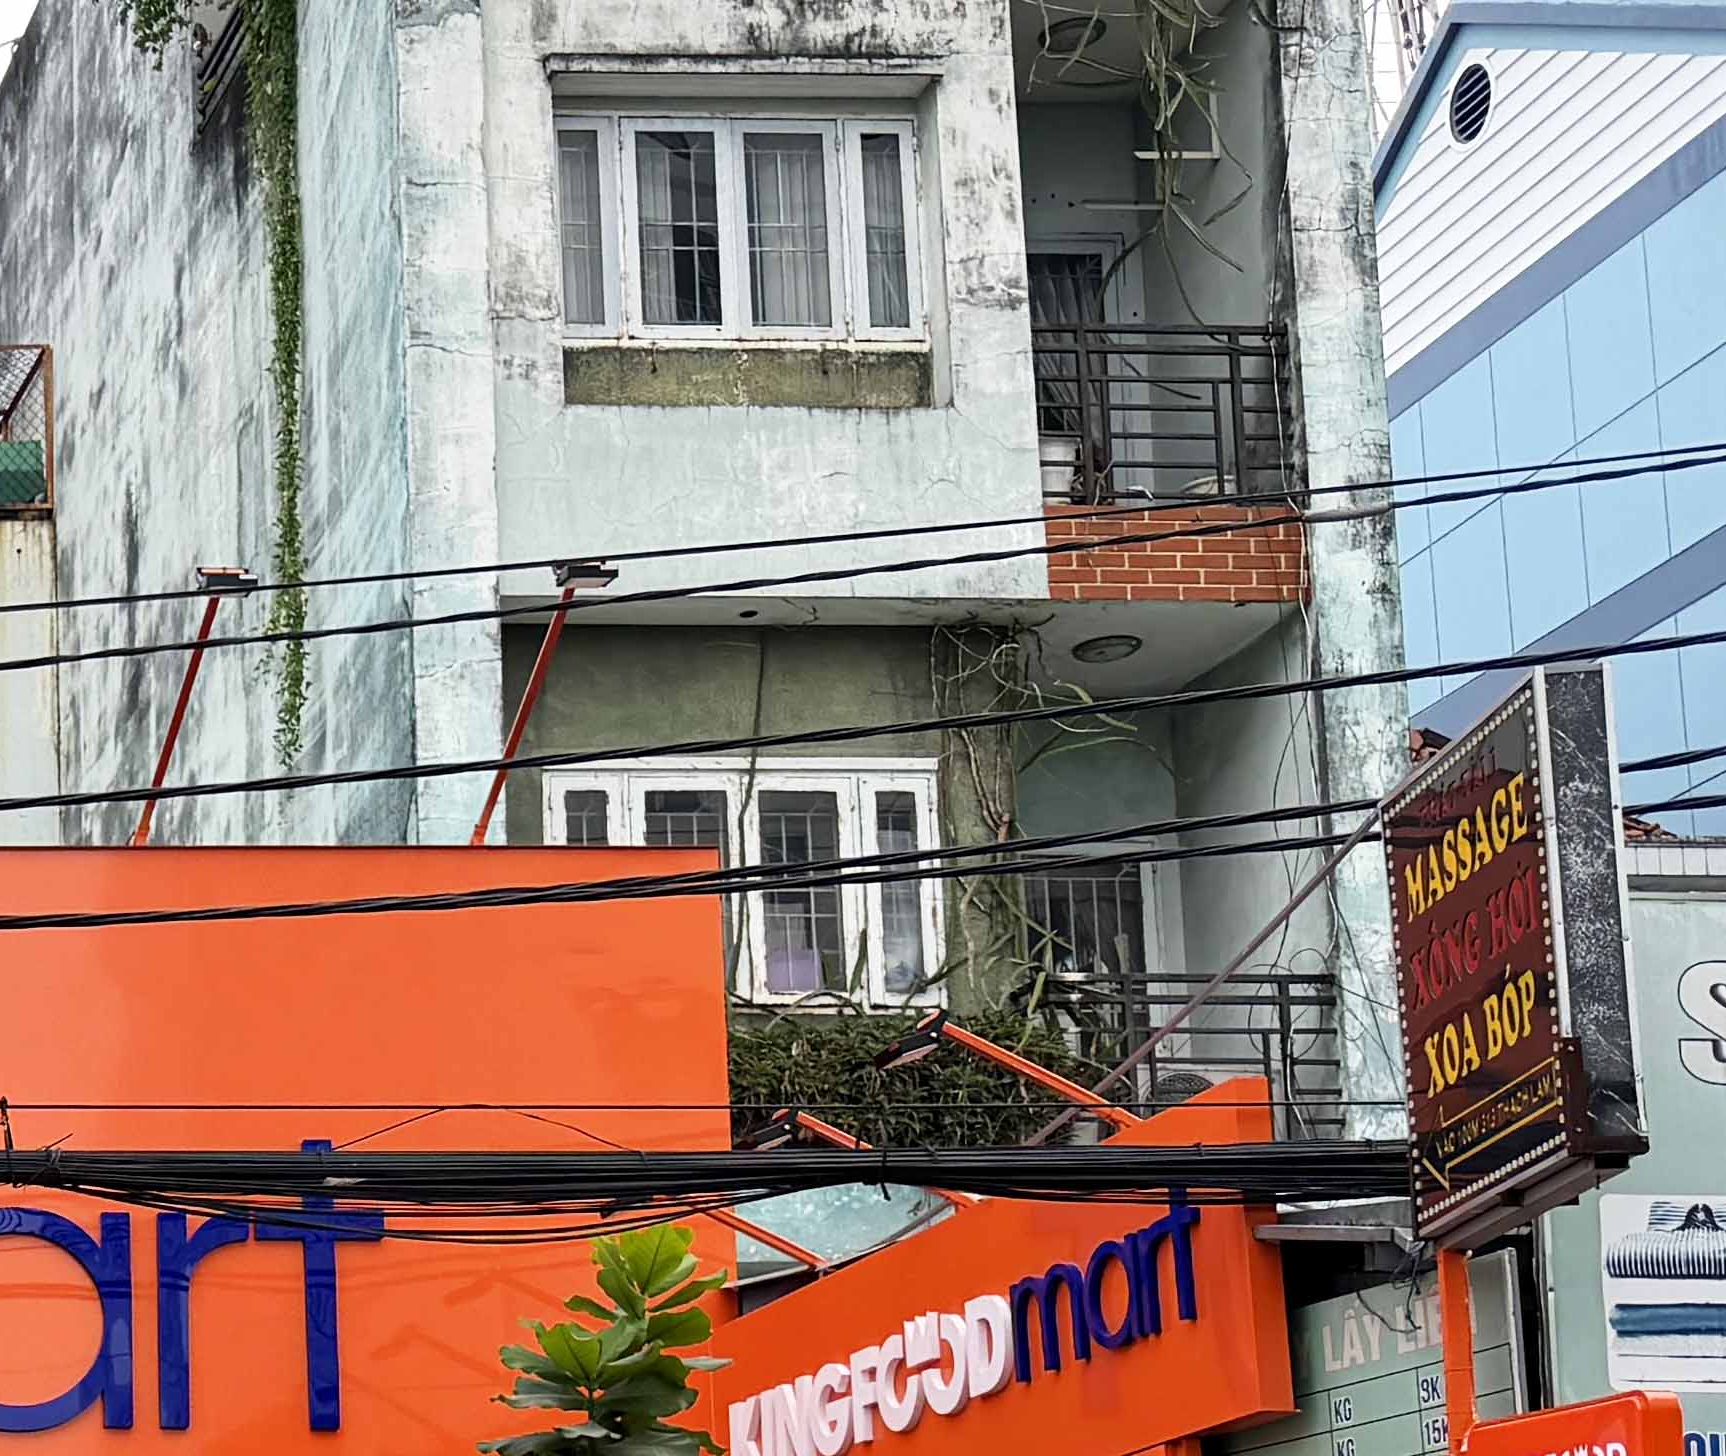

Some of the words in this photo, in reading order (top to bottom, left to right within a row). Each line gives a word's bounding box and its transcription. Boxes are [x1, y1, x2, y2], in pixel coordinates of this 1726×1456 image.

[1403, 773, 1528, 923] MASSAGE
[1426, 1010, 1480, 1100] XOA
[1484, 963, 1537, 1064] BÓP
[1333, 1397, 1353, 1423] KG
